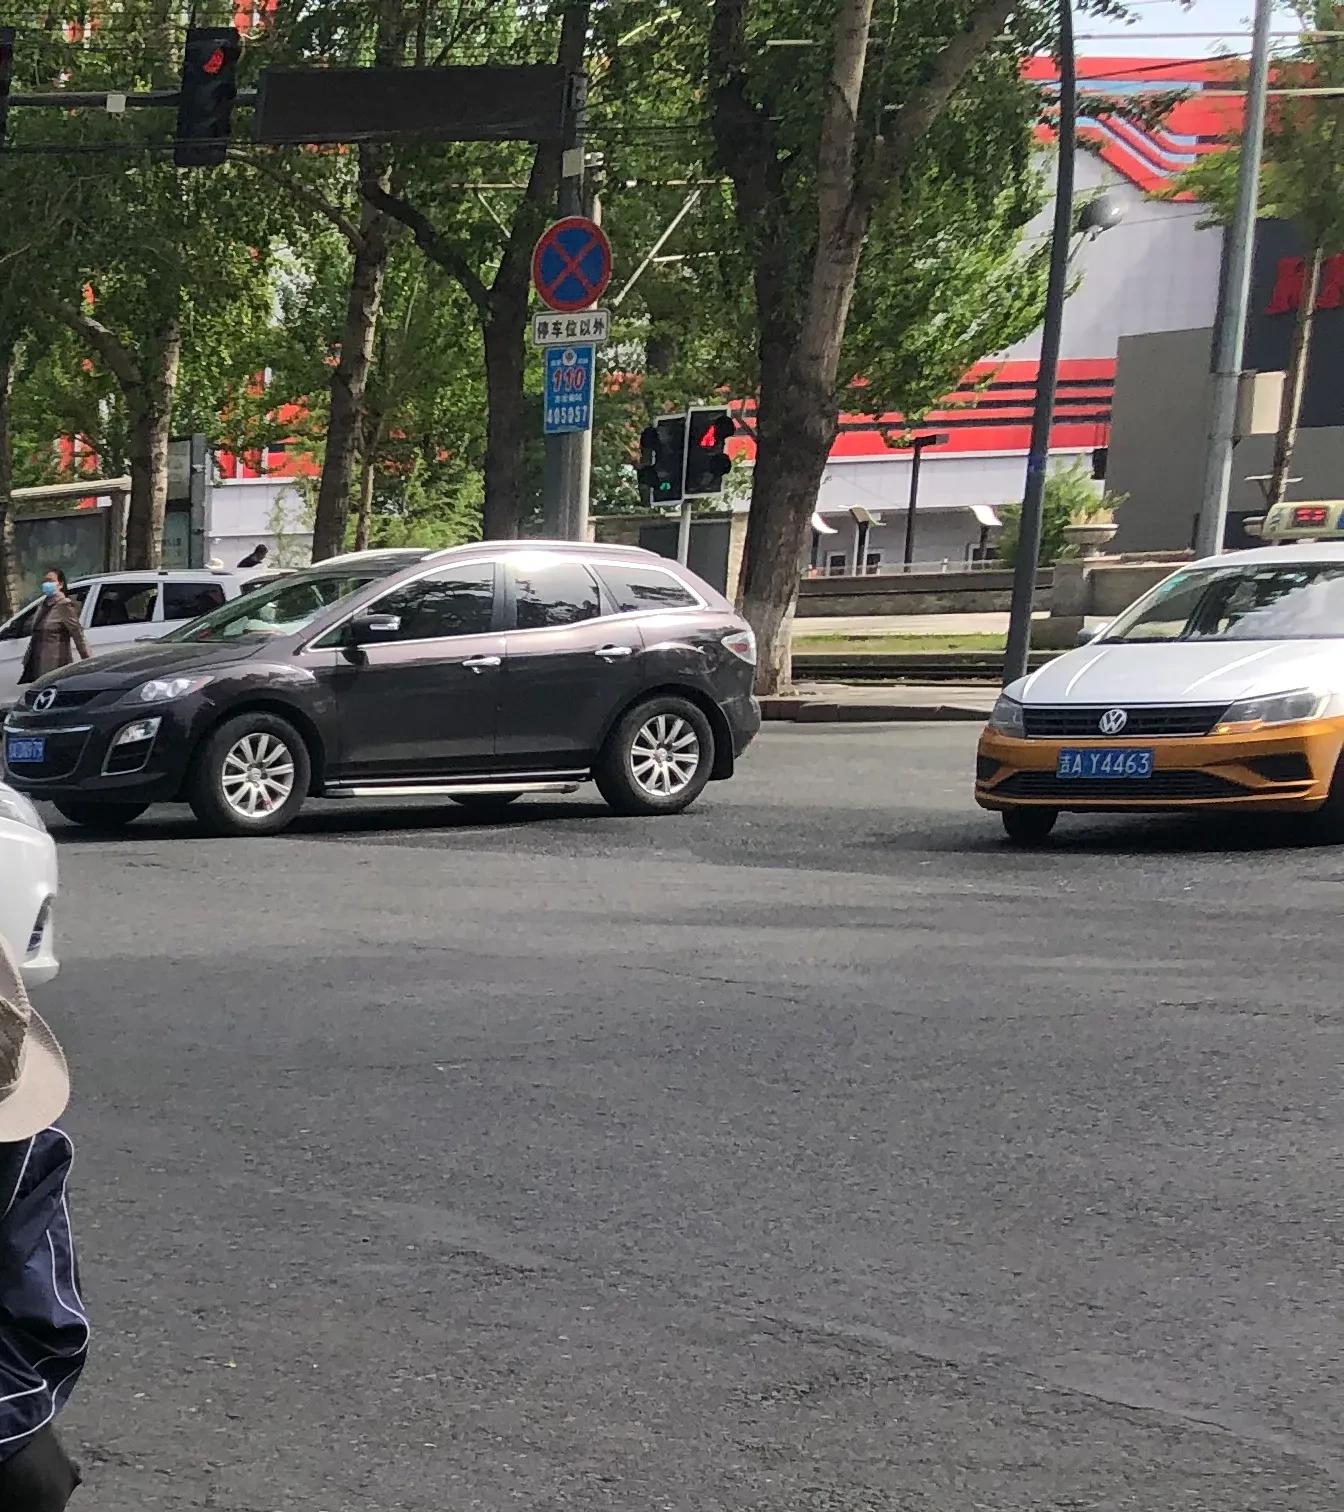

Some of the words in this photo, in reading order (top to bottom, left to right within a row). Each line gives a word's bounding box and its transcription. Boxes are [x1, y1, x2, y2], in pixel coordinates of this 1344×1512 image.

[537, 318, 604, 339] 停车位以外
[553, 366, 586, 392] 110
